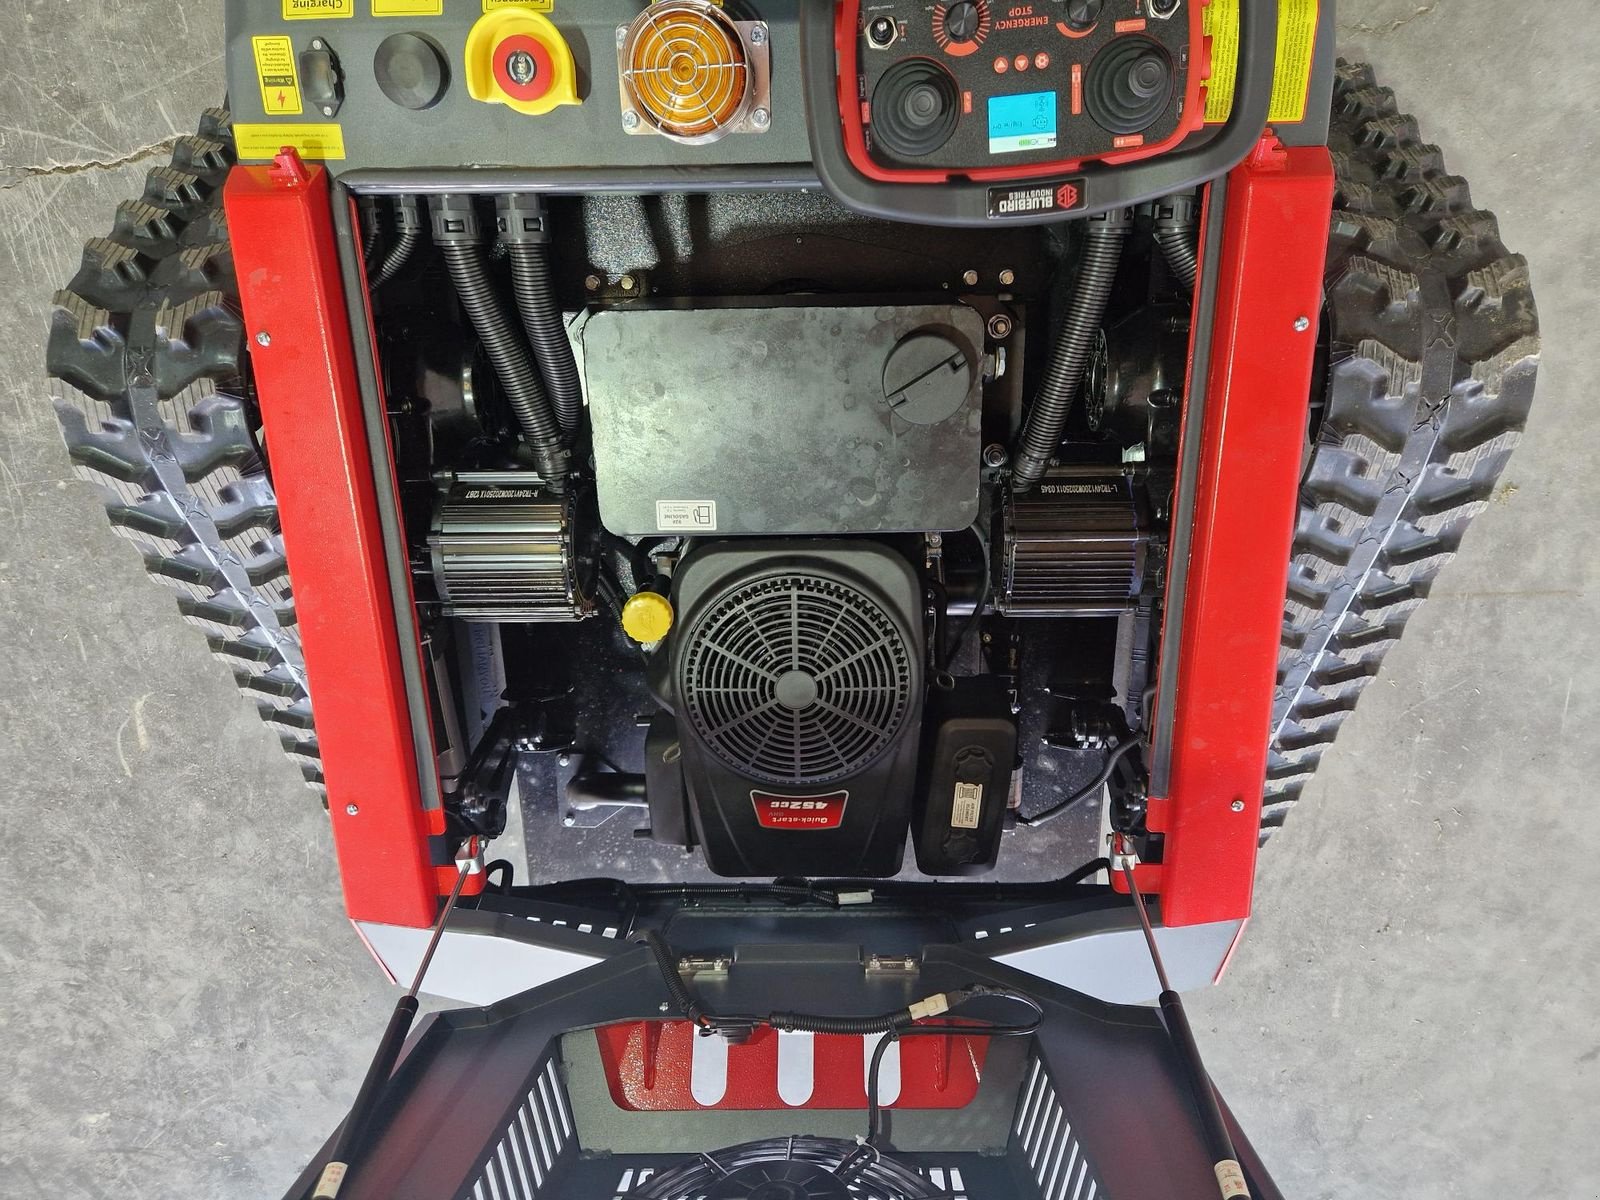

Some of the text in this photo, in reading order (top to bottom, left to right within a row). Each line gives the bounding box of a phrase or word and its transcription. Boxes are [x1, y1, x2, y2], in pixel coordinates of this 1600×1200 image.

[292, 0, 343, 11] Charging
[1008, 6, 1033, 16] STOP
[995, 15, 1049, 30] EMERGENCY
[517, 56, 527, 80] STOP
[1008, 189, 1053, 200] INDUSTRIES
[999, 196, 1053, 212] BLUEBIRD
[770, 801, 828, 809] 452cc
